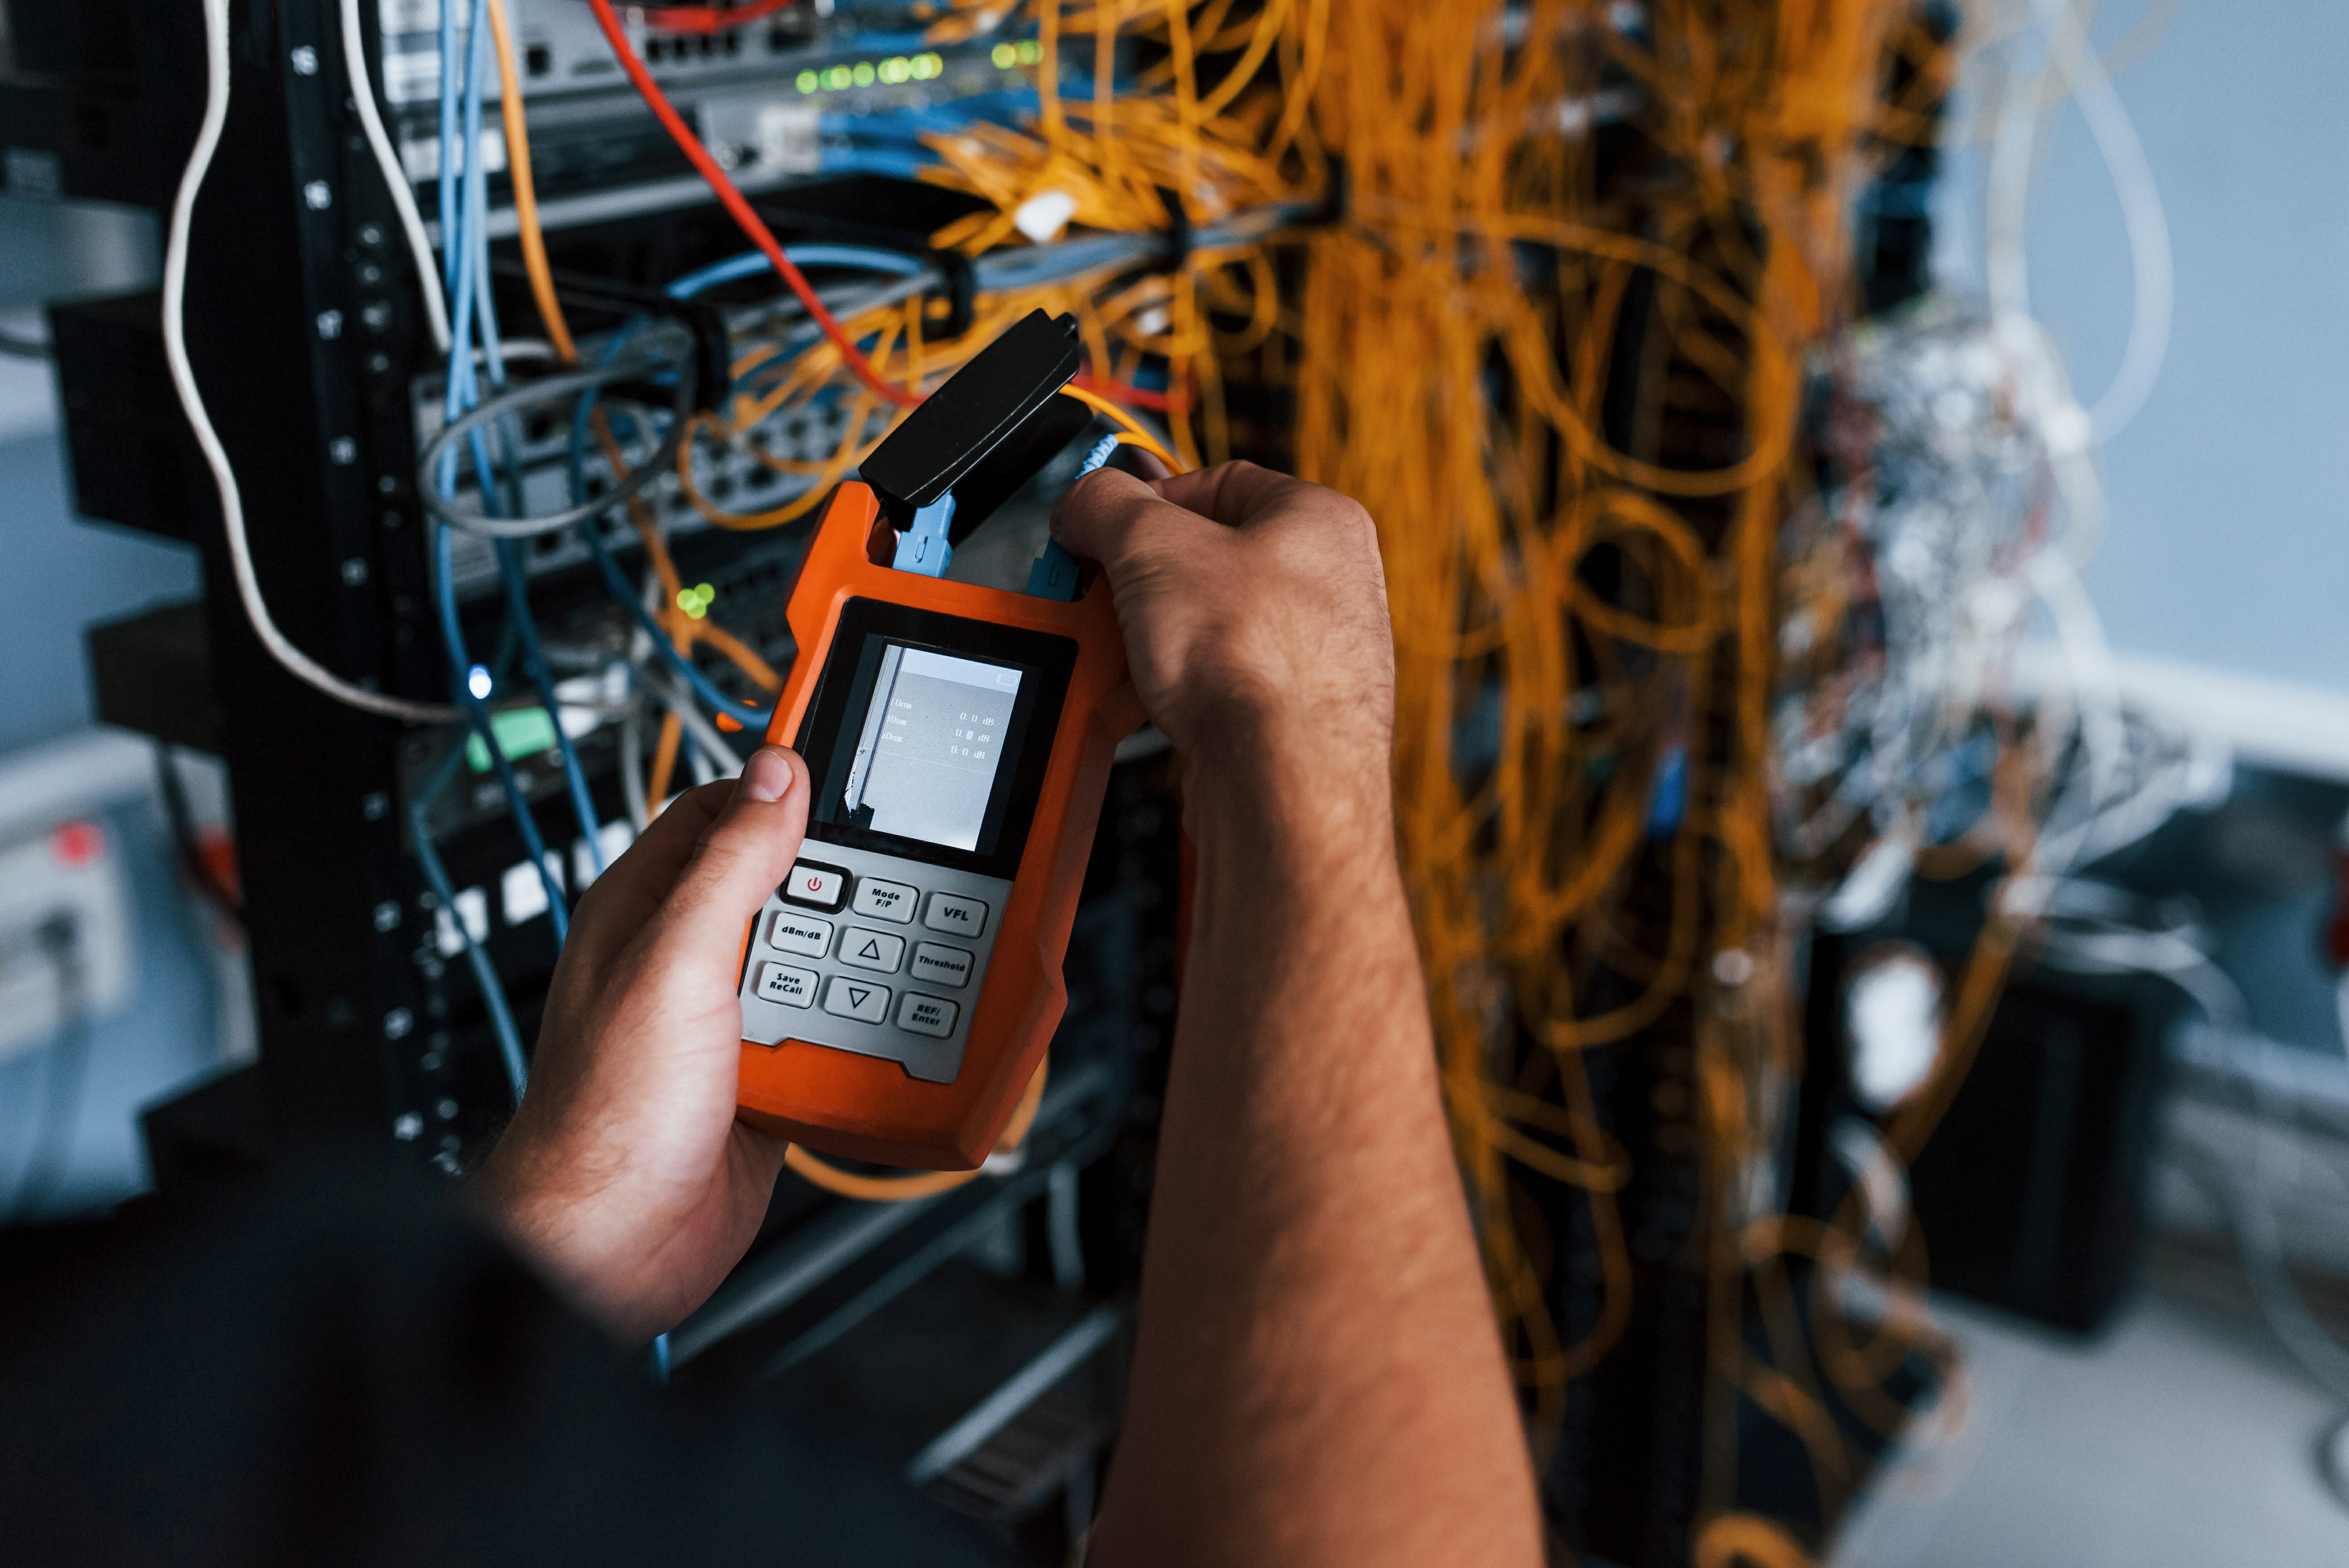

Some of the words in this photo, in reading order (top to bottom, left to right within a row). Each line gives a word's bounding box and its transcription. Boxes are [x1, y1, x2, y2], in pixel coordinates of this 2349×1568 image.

[982, 717, 995, 726] dB
[978, 734, 990, 742] dB
[973, 750, 985, 759] dB
[872, 888, 900, 900] Mode
[875, 899, 892, 907] F/P
[944, 907, 969, 922] VFL
[782, 926, 821, 940] dBm/dB
[919, 956, 966, 972] Threshold
[777, 973, 800, 984] Save
[770, 981, 803, 995] ReCall
[917, 1004, 941, 1016] REF/
[912, 1013, 941, 1025] Enter
